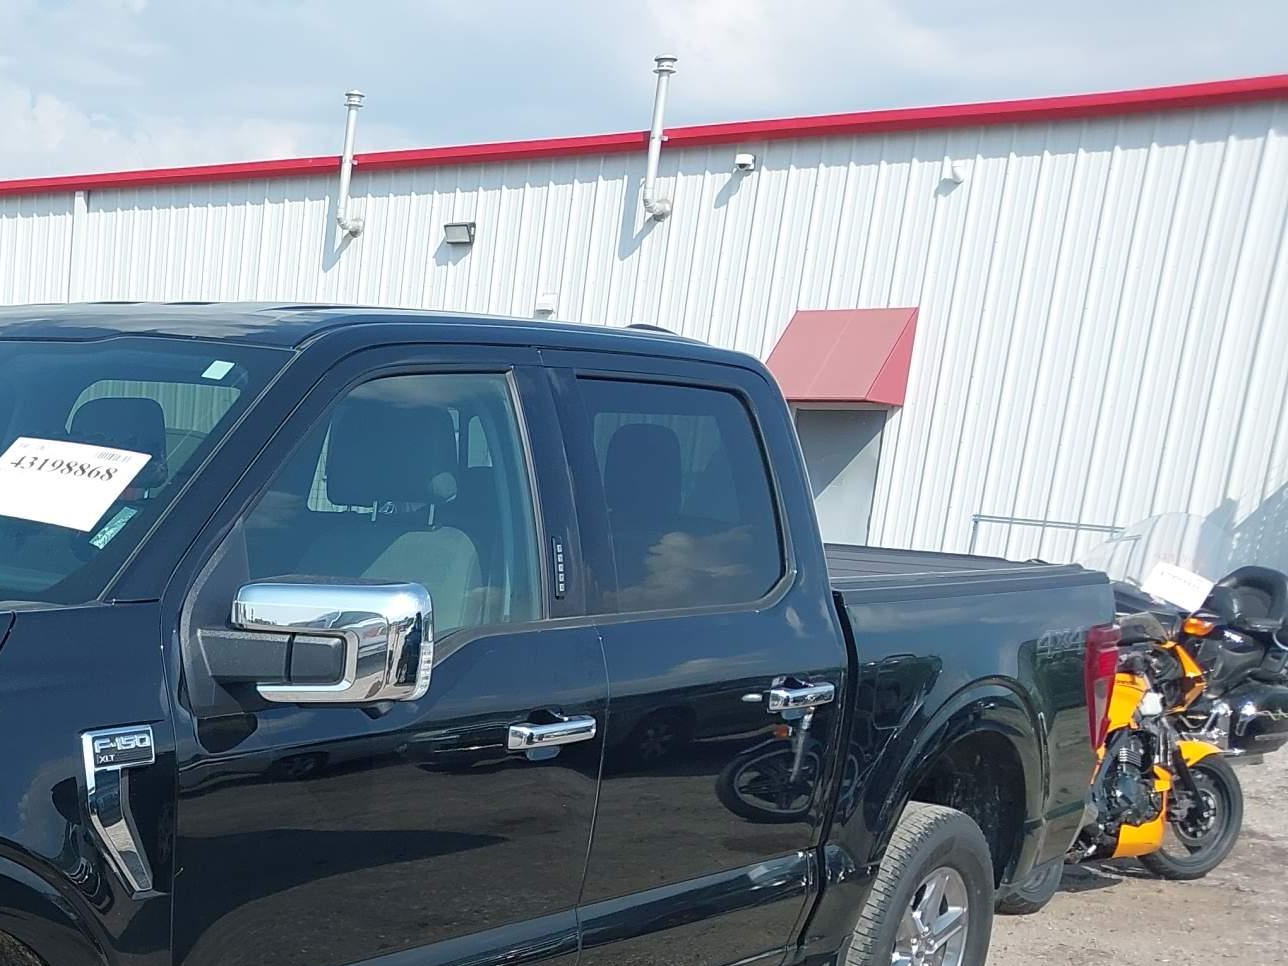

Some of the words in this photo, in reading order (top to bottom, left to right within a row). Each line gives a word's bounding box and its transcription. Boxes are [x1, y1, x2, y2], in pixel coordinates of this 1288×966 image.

[10, 455, 118, 481] 43198868
[94, 733, 151, 753] F-150
[99, 754, 116, 764] XLT
